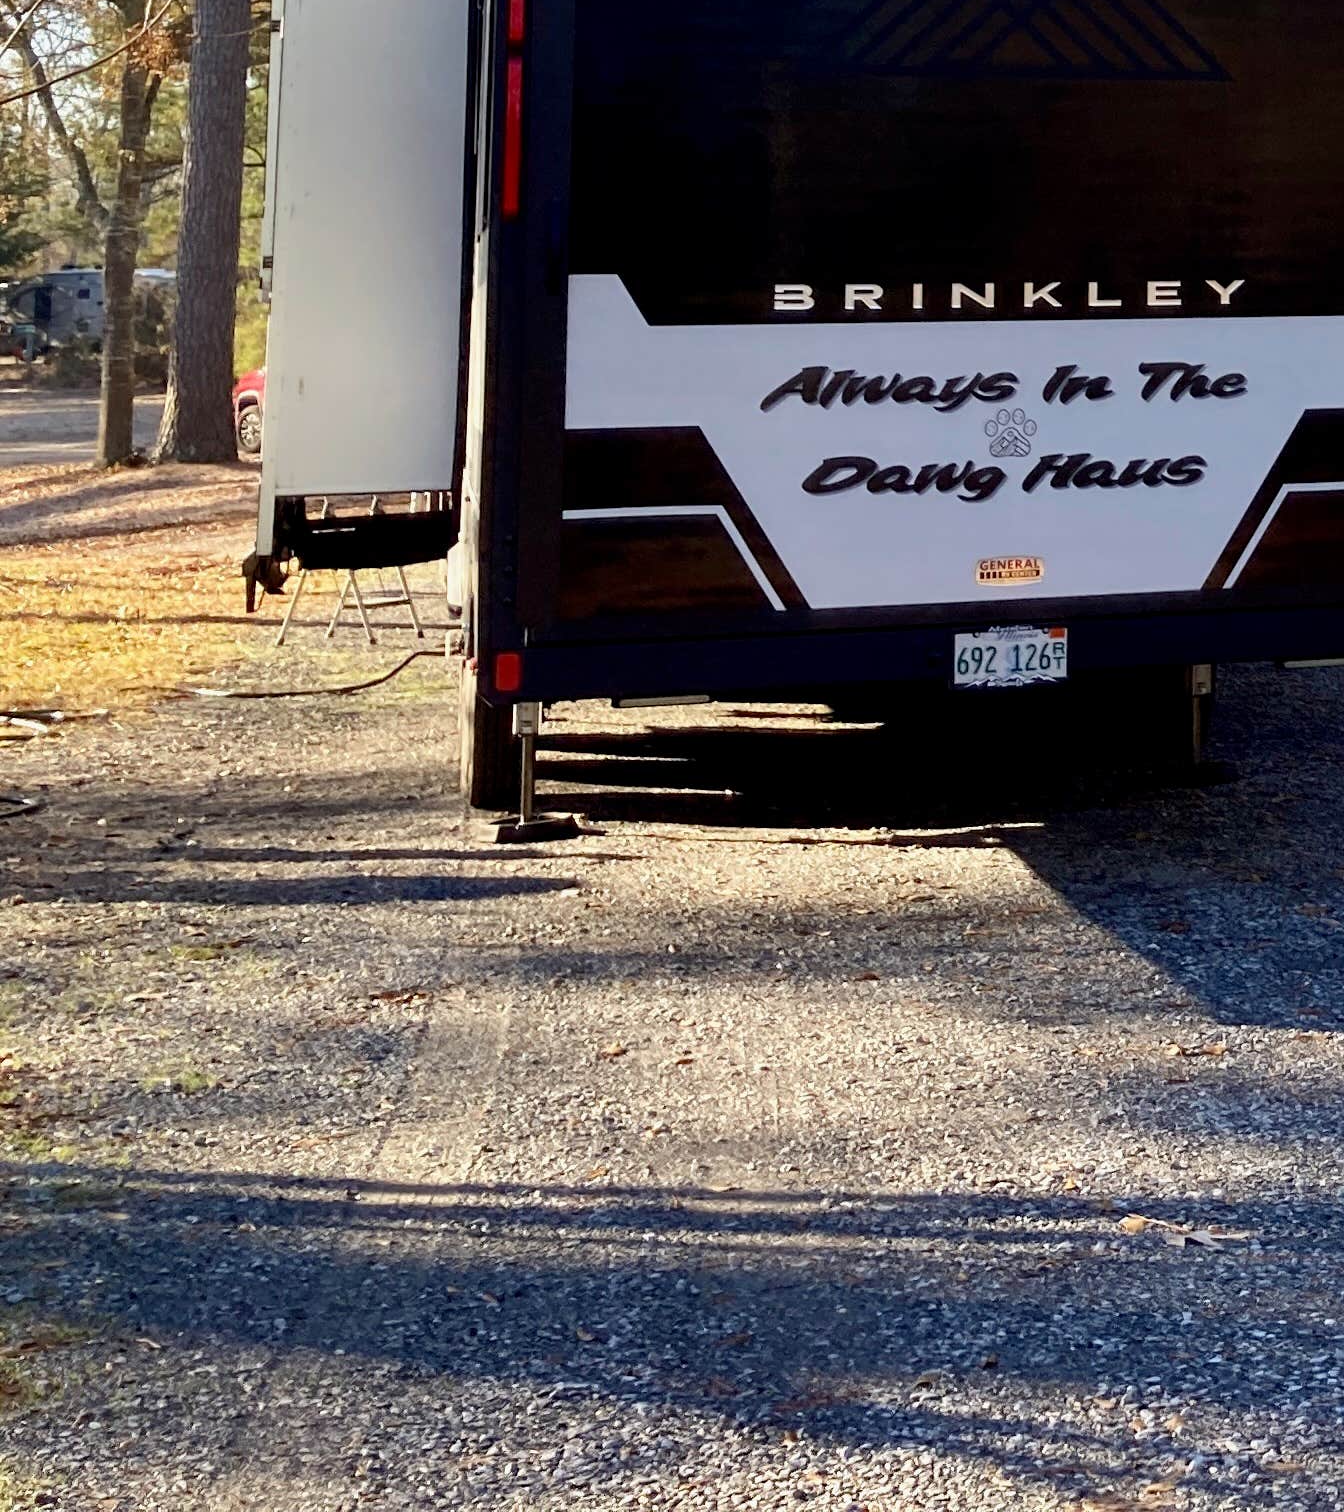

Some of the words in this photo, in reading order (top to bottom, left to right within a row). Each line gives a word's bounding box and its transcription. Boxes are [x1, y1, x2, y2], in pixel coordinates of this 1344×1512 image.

[773, 279, 1245, 311] BRINKLEY
[760, 365, 1018, 413] Always
[1042, 364, 1113, 405] In
[1139, 361, 1248, 403] The
[802, 455, 1007, 502] Dawg
[1022, 453, 1208, 494] Haus
[980, 559, 1040, 570] GENERAL
[957, 645, 997, 675] 692
[1010, 642, 1051, 672] 126
